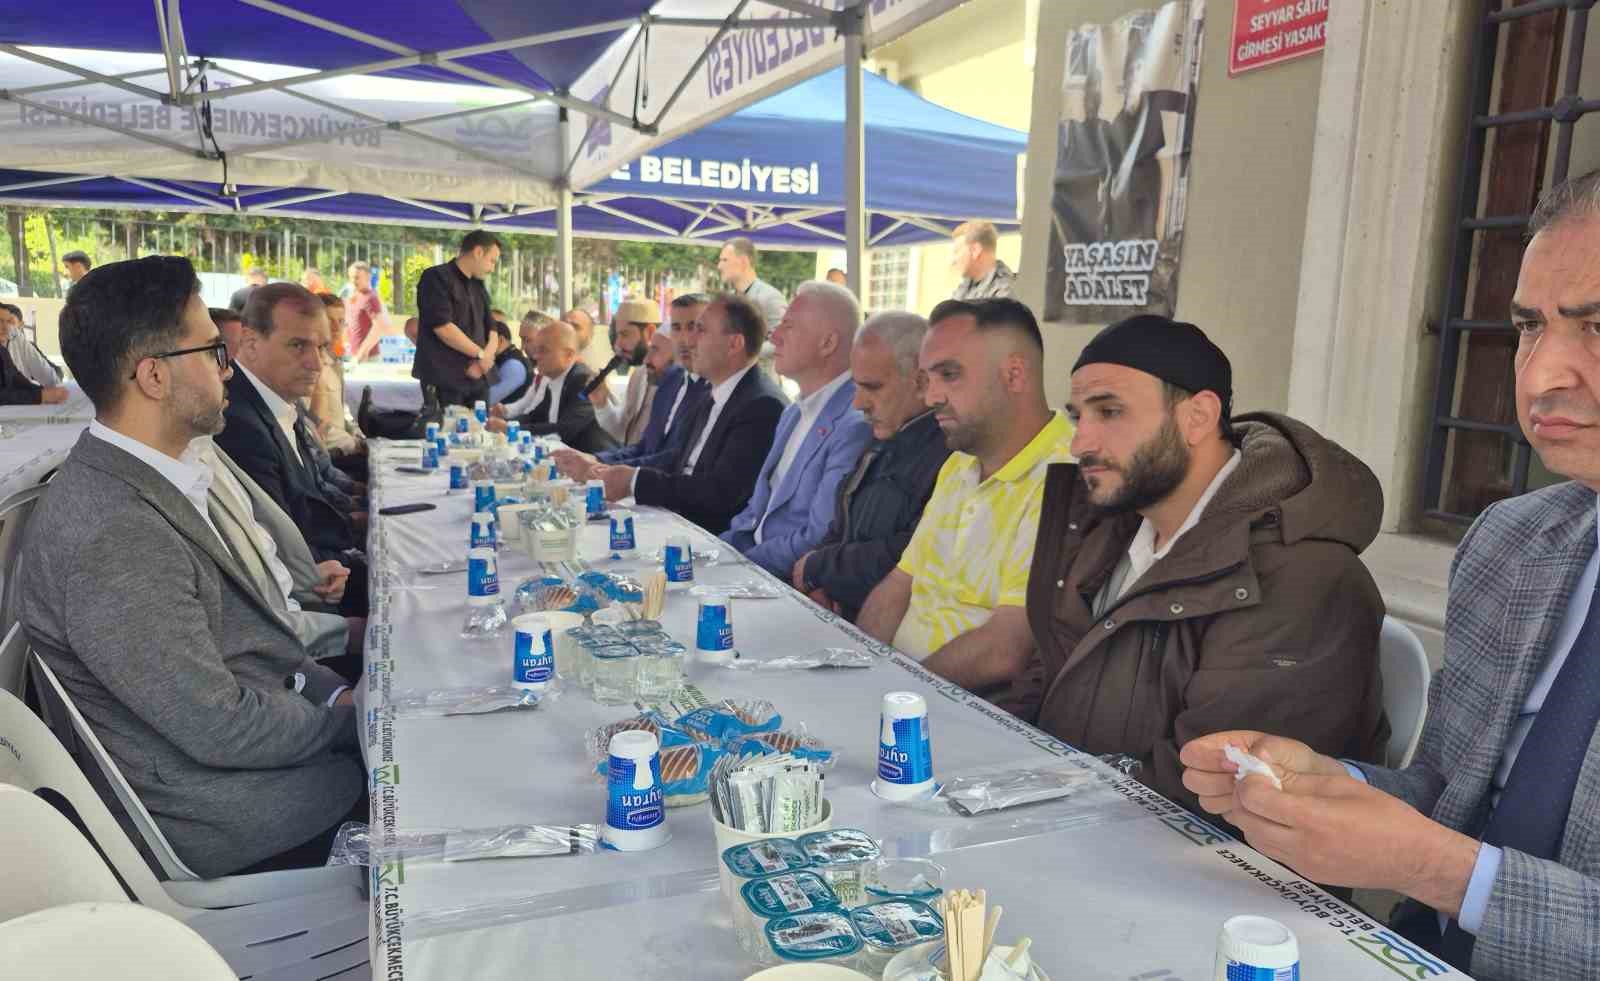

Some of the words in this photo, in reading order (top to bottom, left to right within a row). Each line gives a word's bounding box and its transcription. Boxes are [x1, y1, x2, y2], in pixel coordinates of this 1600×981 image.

[1249, 5, 1295, 33] SEYYAR
[1238, 32, 1283, 61] GİRMESİ
[640, 155, 819, 195] BELEDİYESİ
[1065, 242, 1157, 272] YAŞASIN
[1065, 276, 1148, 303] ADALET
[622, 786, 662, 807] ayran
[1215, 848, 1330, 919] BÜYÜKÇEKMECE
[1288, 880, 1376, 932] BELEDİYESİ
[1329, 916, 1356, 936] T.C.
